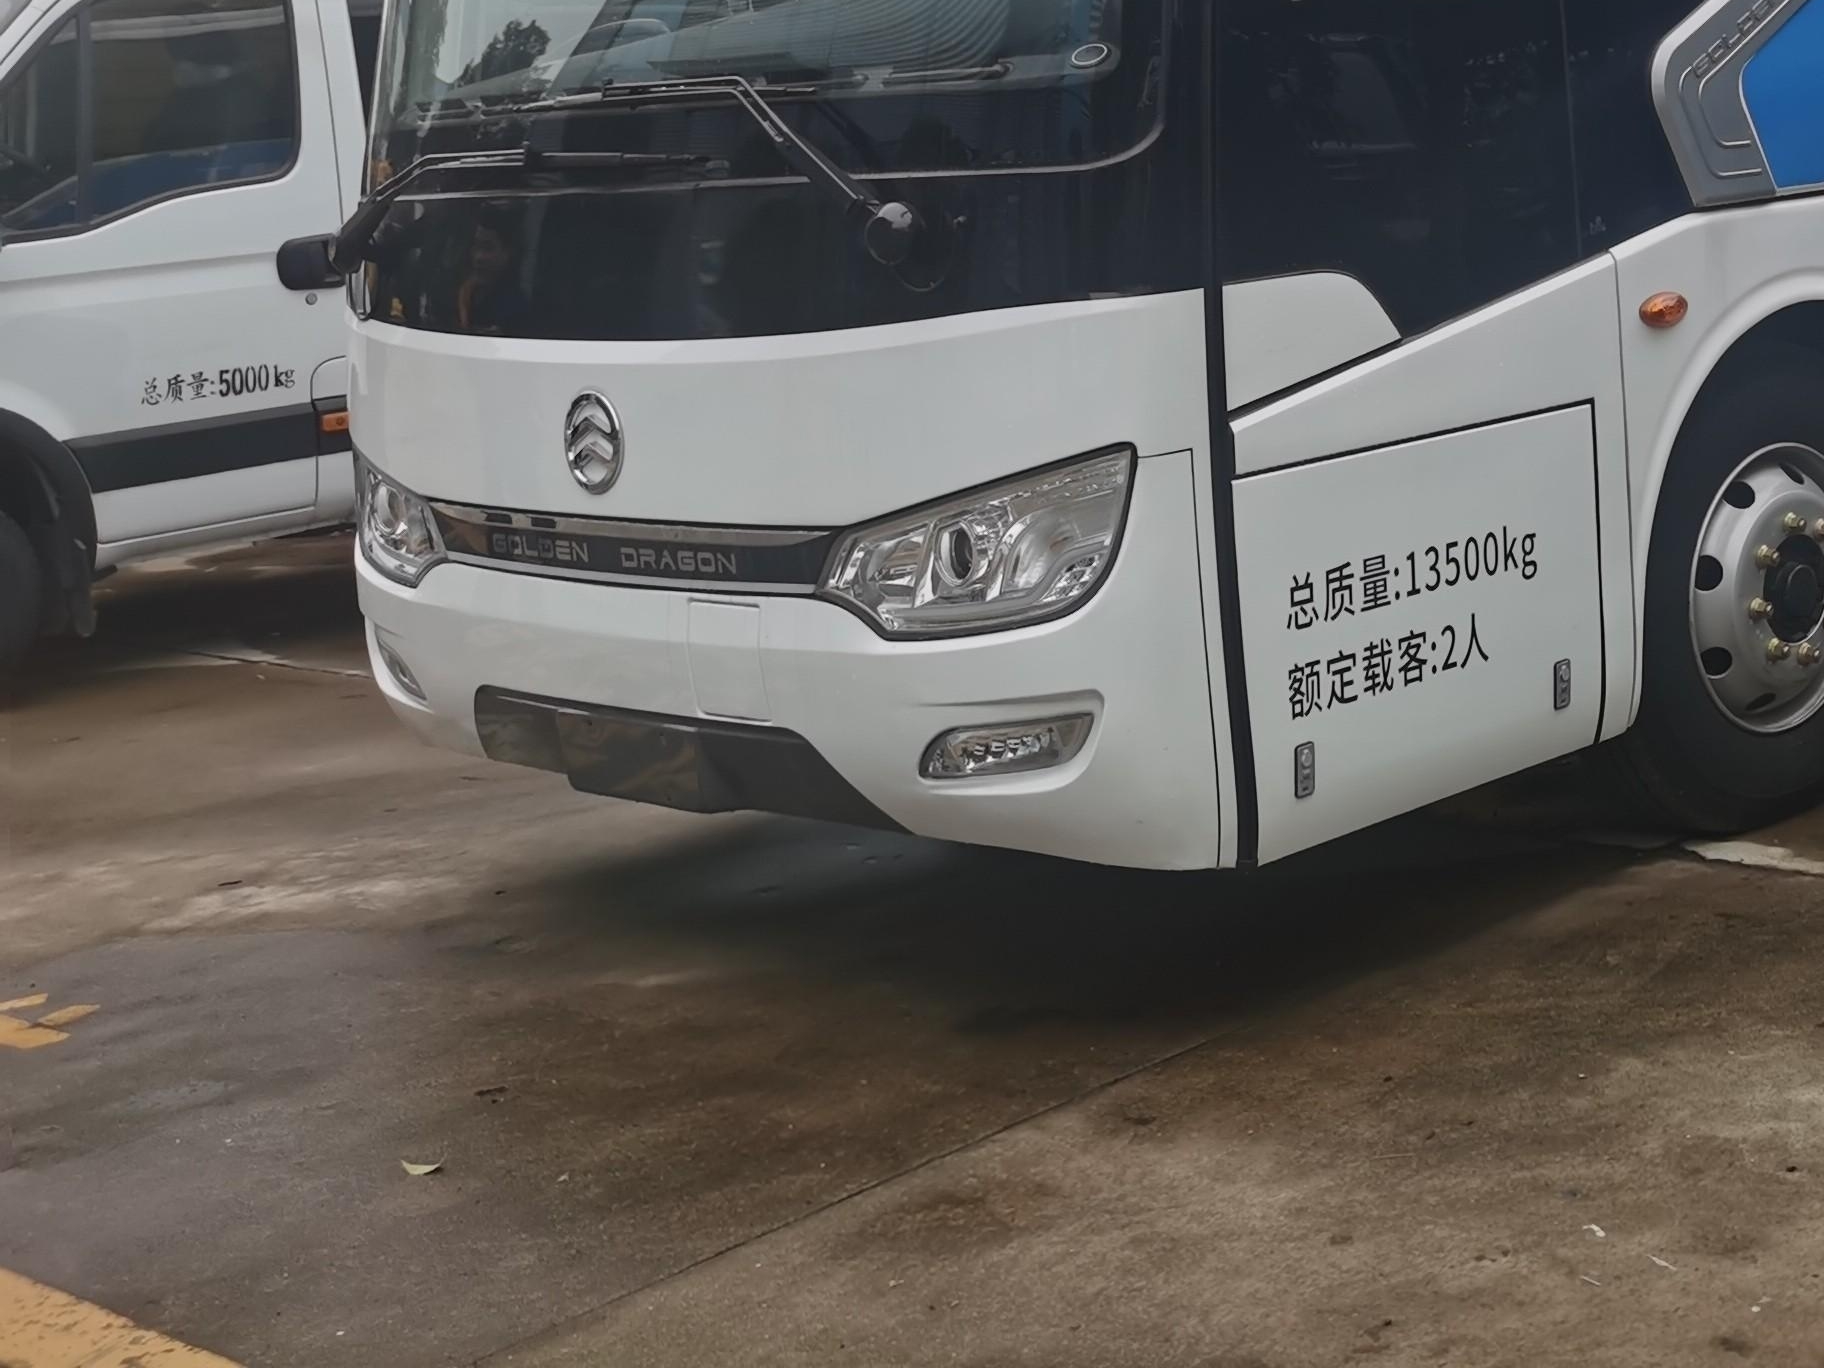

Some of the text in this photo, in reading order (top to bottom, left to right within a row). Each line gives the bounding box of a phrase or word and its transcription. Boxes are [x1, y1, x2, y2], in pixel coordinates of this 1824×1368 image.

[492, 533, 738, 575] GOLDEN DRAGON
[1286, 525, 1538, 630] 总质量:13500kg
[1287, 612, 1490, 720] 额定载客:2人
